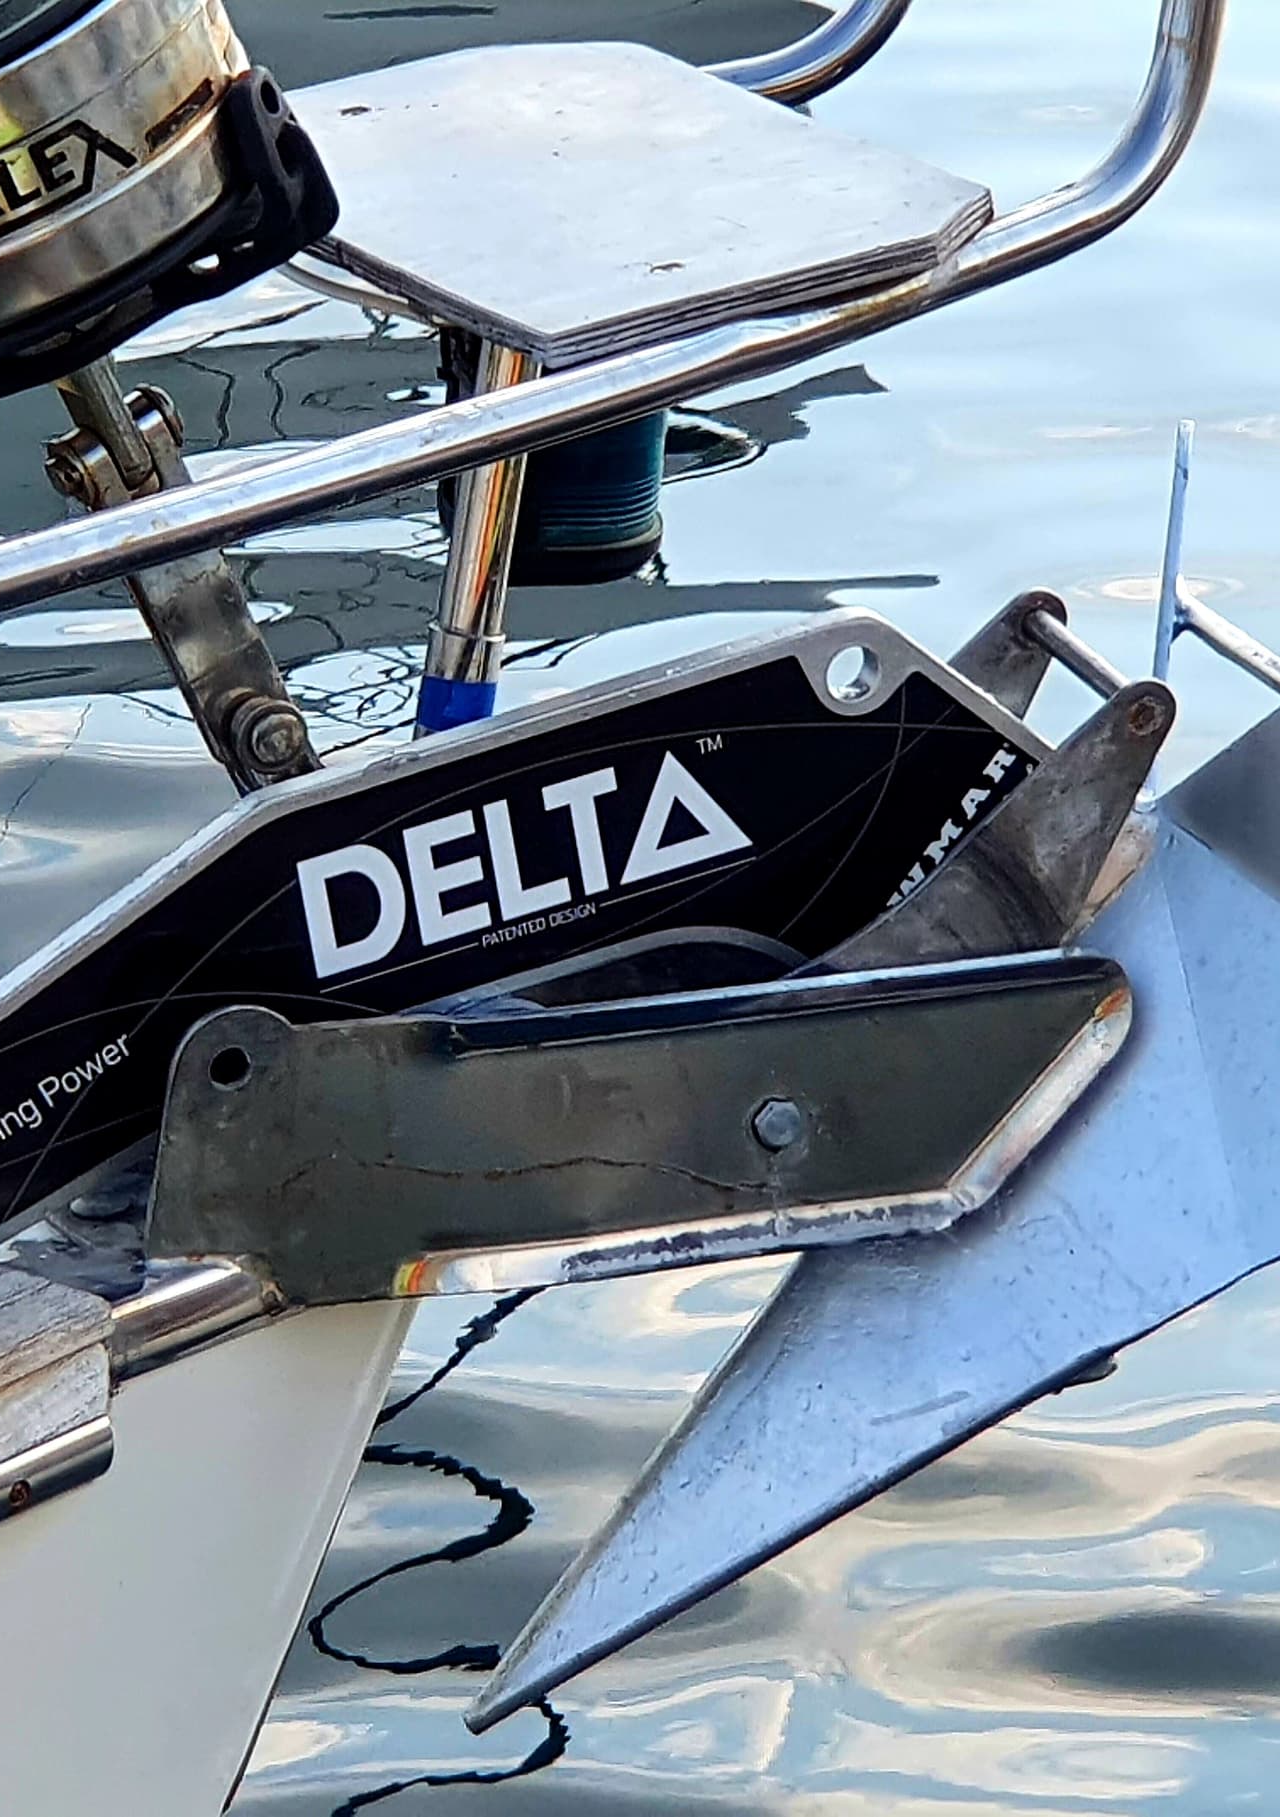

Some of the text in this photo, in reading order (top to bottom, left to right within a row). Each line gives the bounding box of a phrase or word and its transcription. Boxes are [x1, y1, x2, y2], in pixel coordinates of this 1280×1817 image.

[296, 750, 754, 979] DELTA
[482, 902, 597, 948] PATENTED DESIGN
[37, 1033, 130, 1106] Power
